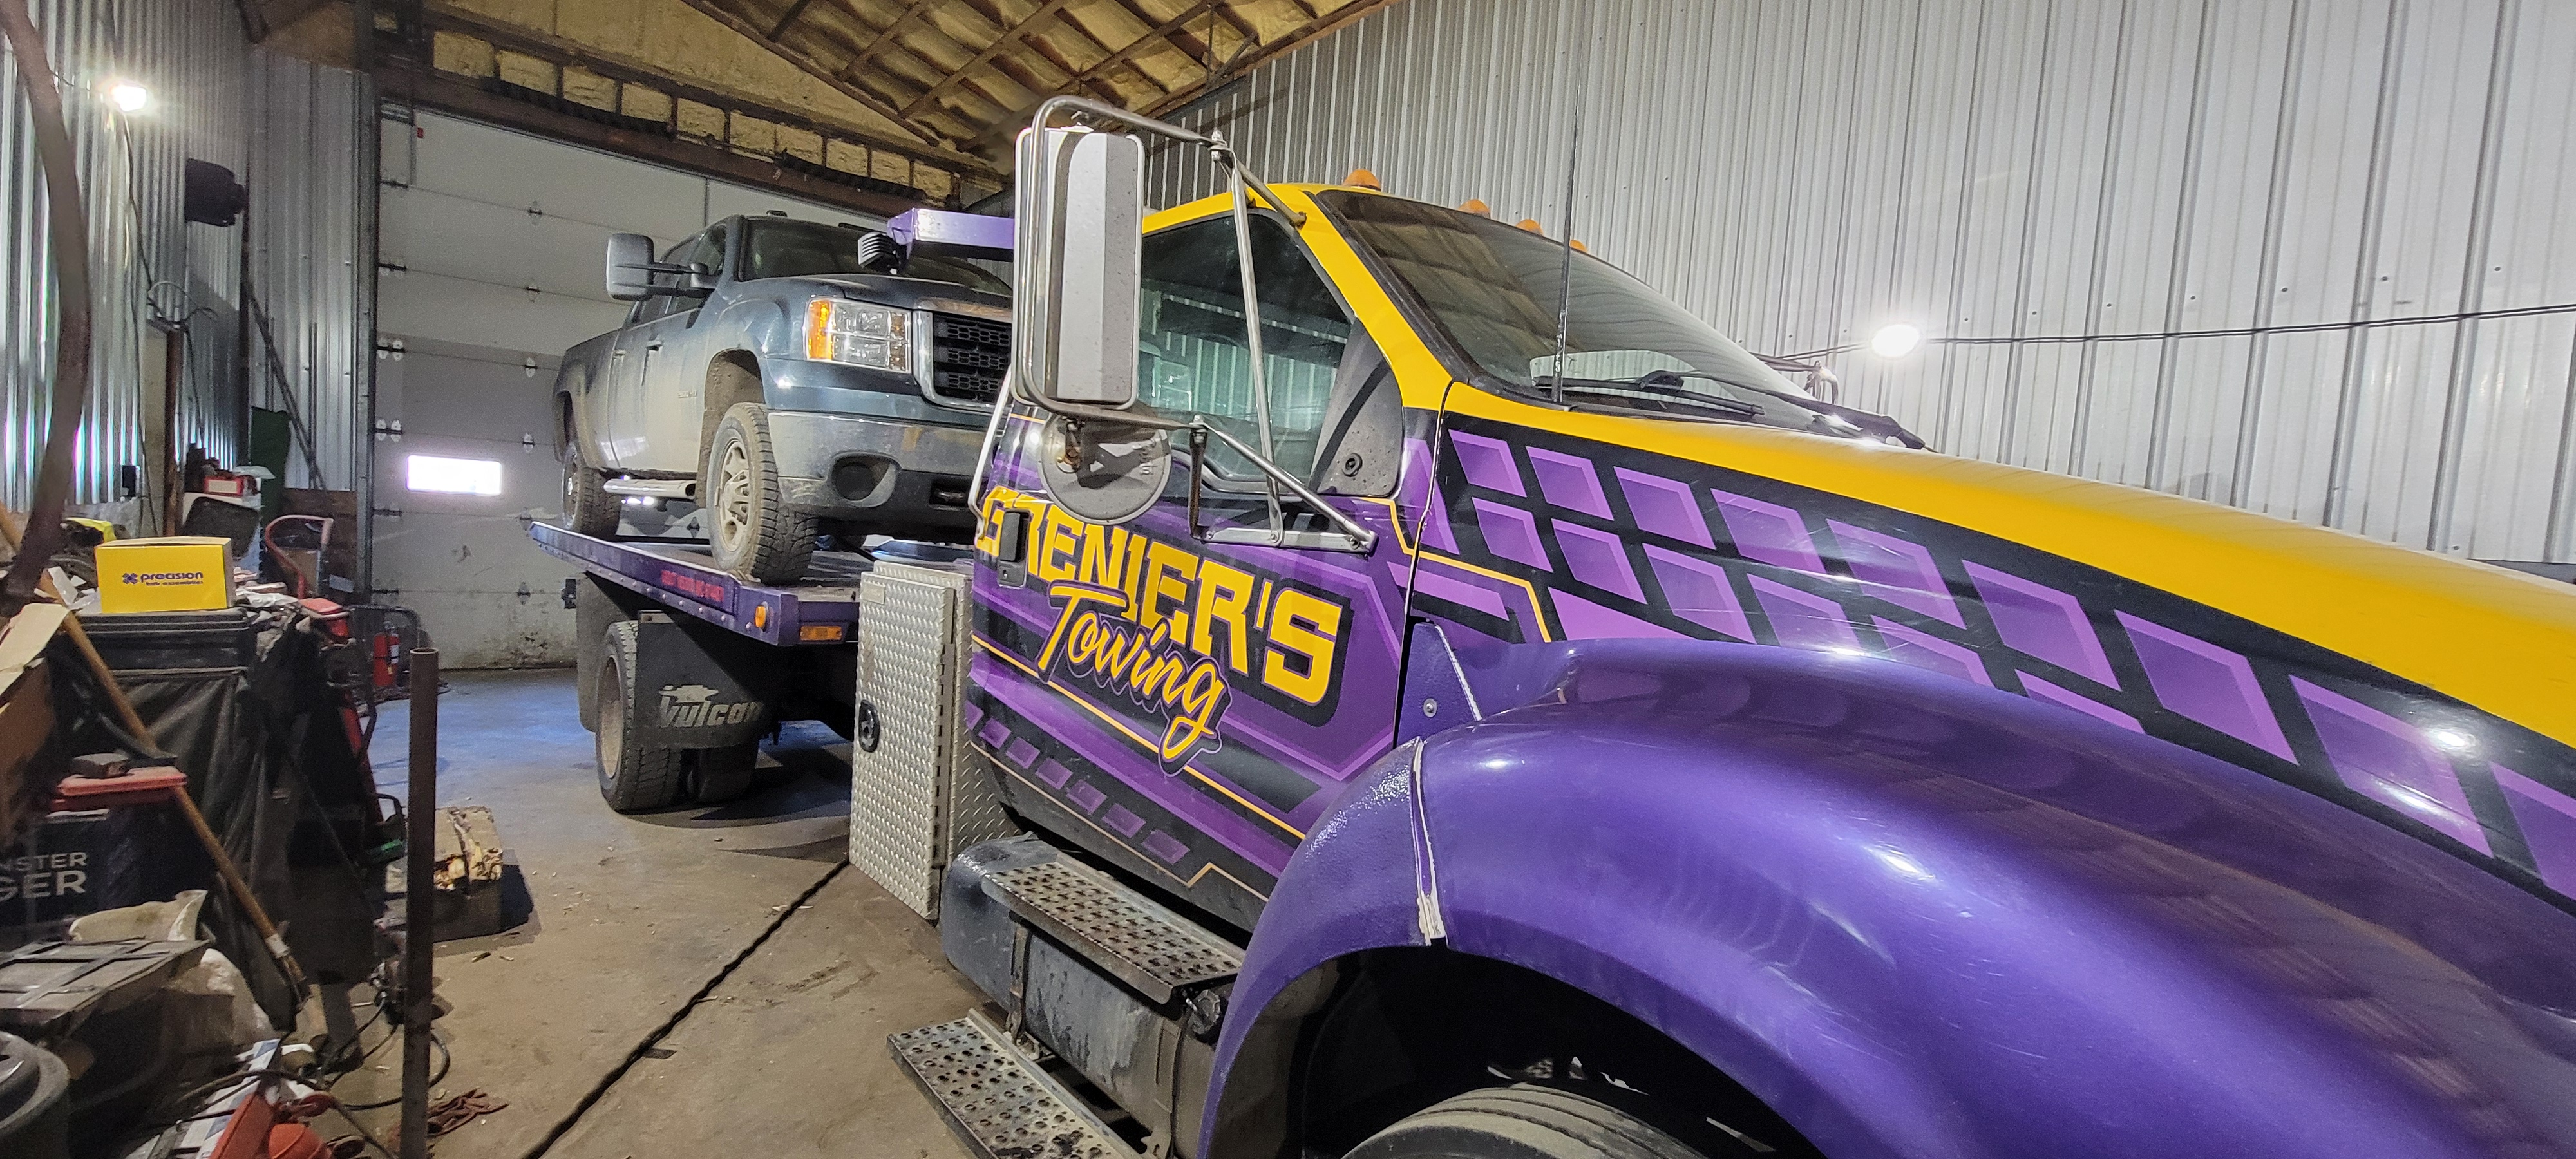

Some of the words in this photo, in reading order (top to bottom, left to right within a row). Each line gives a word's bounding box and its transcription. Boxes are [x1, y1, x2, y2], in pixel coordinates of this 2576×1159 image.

[140, 572, 204, 583] precision
[976, 486, 1343, 704] GRENIER'S
[1036, 583, 1226, 761] Towing
